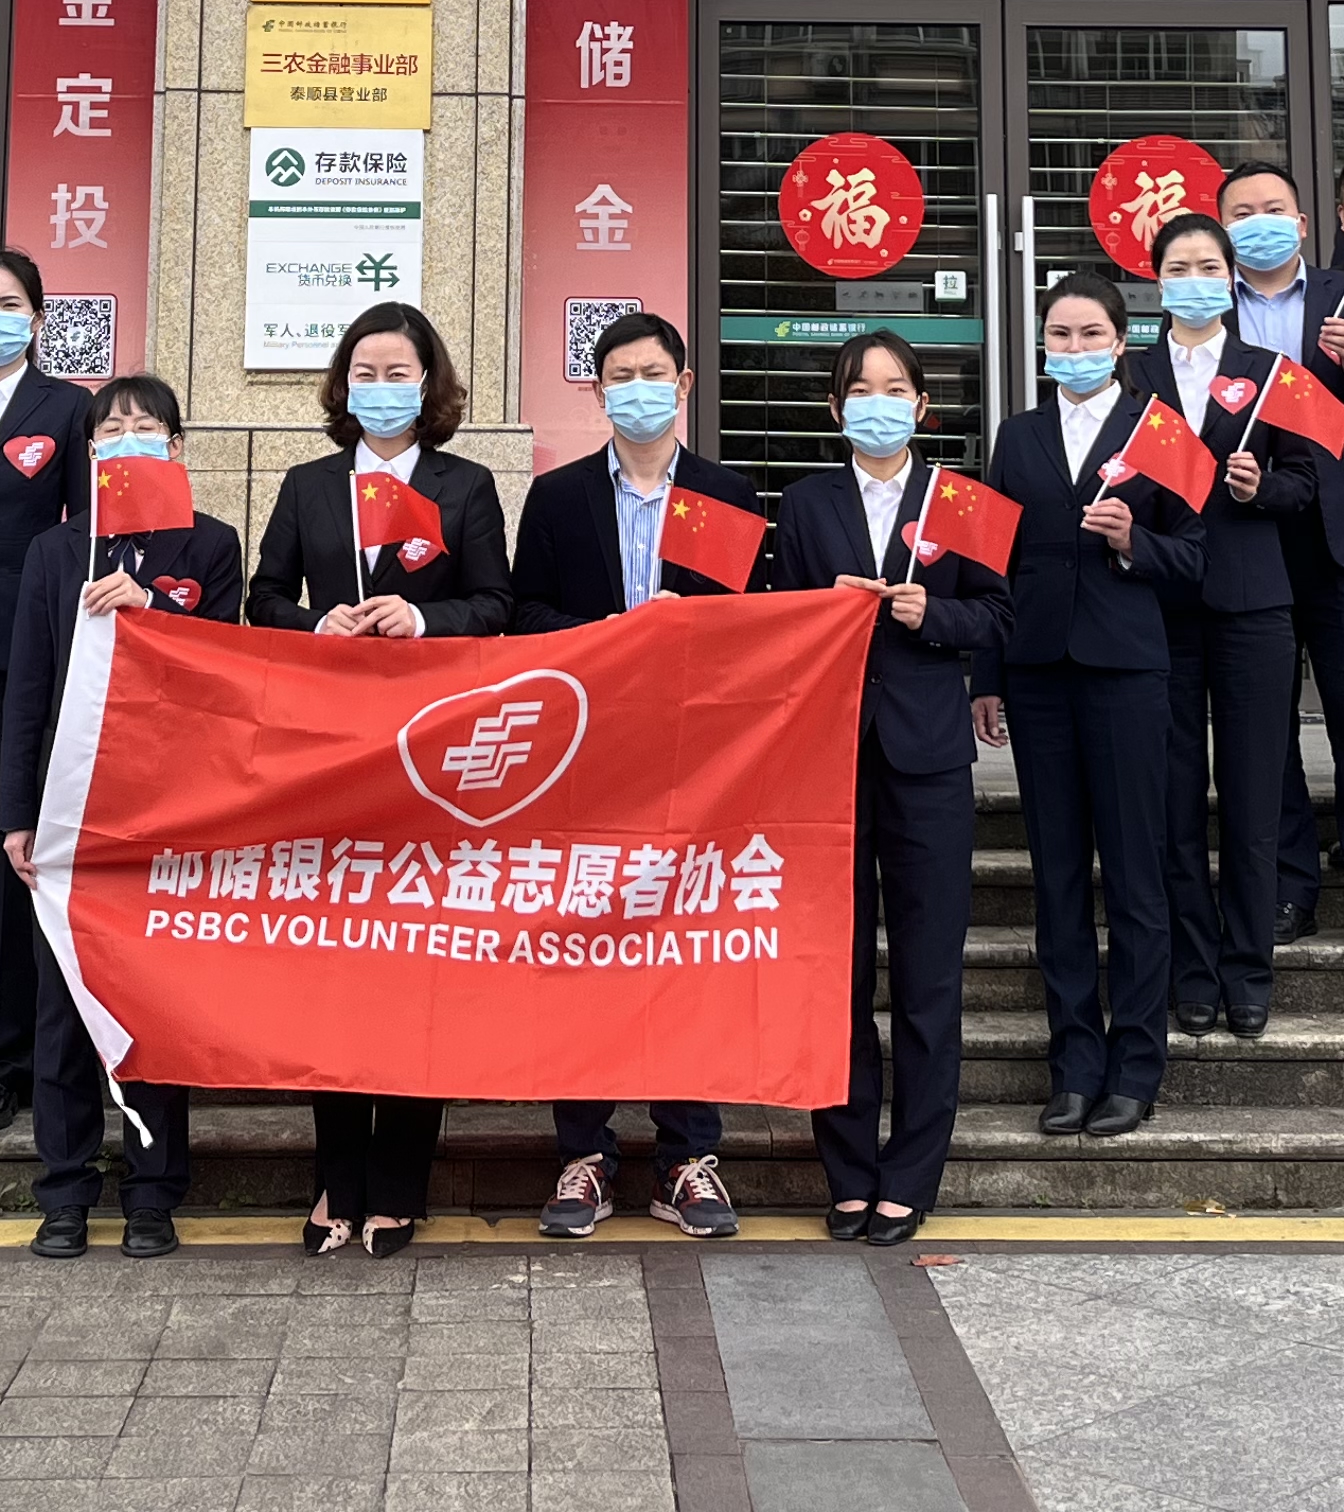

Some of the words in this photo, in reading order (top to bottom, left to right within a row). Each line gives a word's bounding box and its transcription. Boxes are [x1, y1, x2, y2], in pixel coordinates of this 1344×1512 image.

[260, 52, 418, 76] 三农金融事业部
[290, 86, 388, 103] 泰顺县营业部
[315, 151, 407, 174] 存款保险
[315, 177, 352, 186] DEPOSIT
[355, 178, 407, 186] INSURANCE
[810, 167, 891, 250] 福
[265, 263, 353, 273] EXCHANGE
[298, 275, 352, 287] 货币兑换
[943, 274, 958, 290] 拉
[146, 833, 785, 921] 邮储银行公益志愿者协会
[145, 910, 249, 944] PSBC
[261, 914, 500, 963] VOLUNTEER
[507, 928, 779, 967] ASSOCIATION
